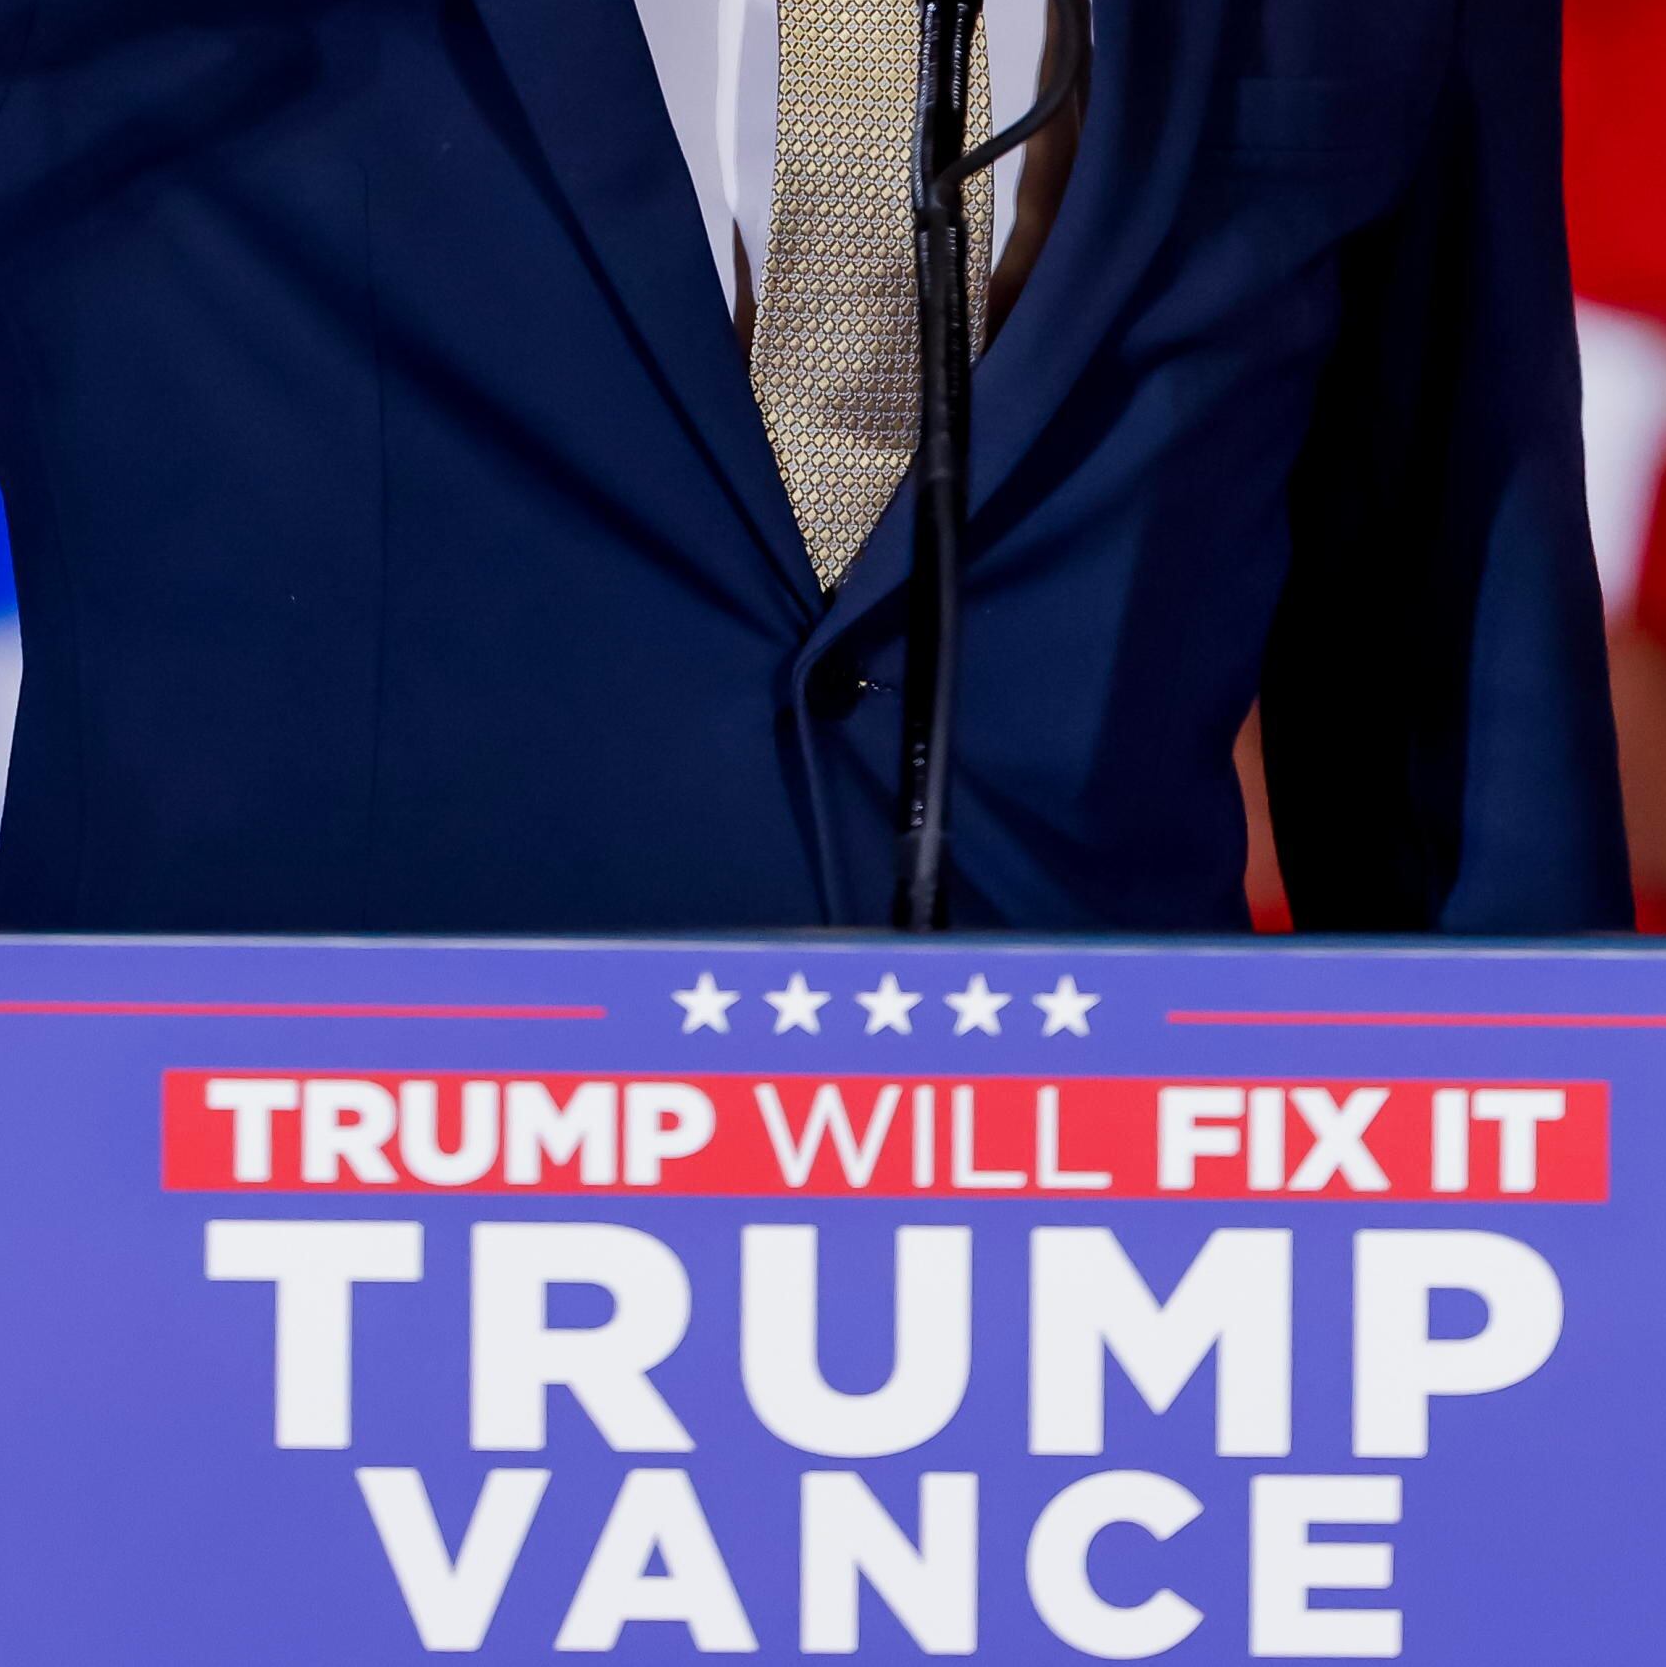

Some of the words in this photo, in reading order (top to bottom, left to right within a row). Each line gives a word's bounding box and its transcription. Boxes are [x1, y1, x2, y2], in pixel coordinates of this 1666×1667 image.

[206, 1078, 715, 1185] TRUMP
[755, 1083, 1111, 1190] WILL
[1158, 1086, 1389, 1192] FIX
[1433, 1089, 1565, 1193] IT
[205, 1219, 1564, 1459] TRUMP
[356, 1466, 1403, 1660] VANCE
